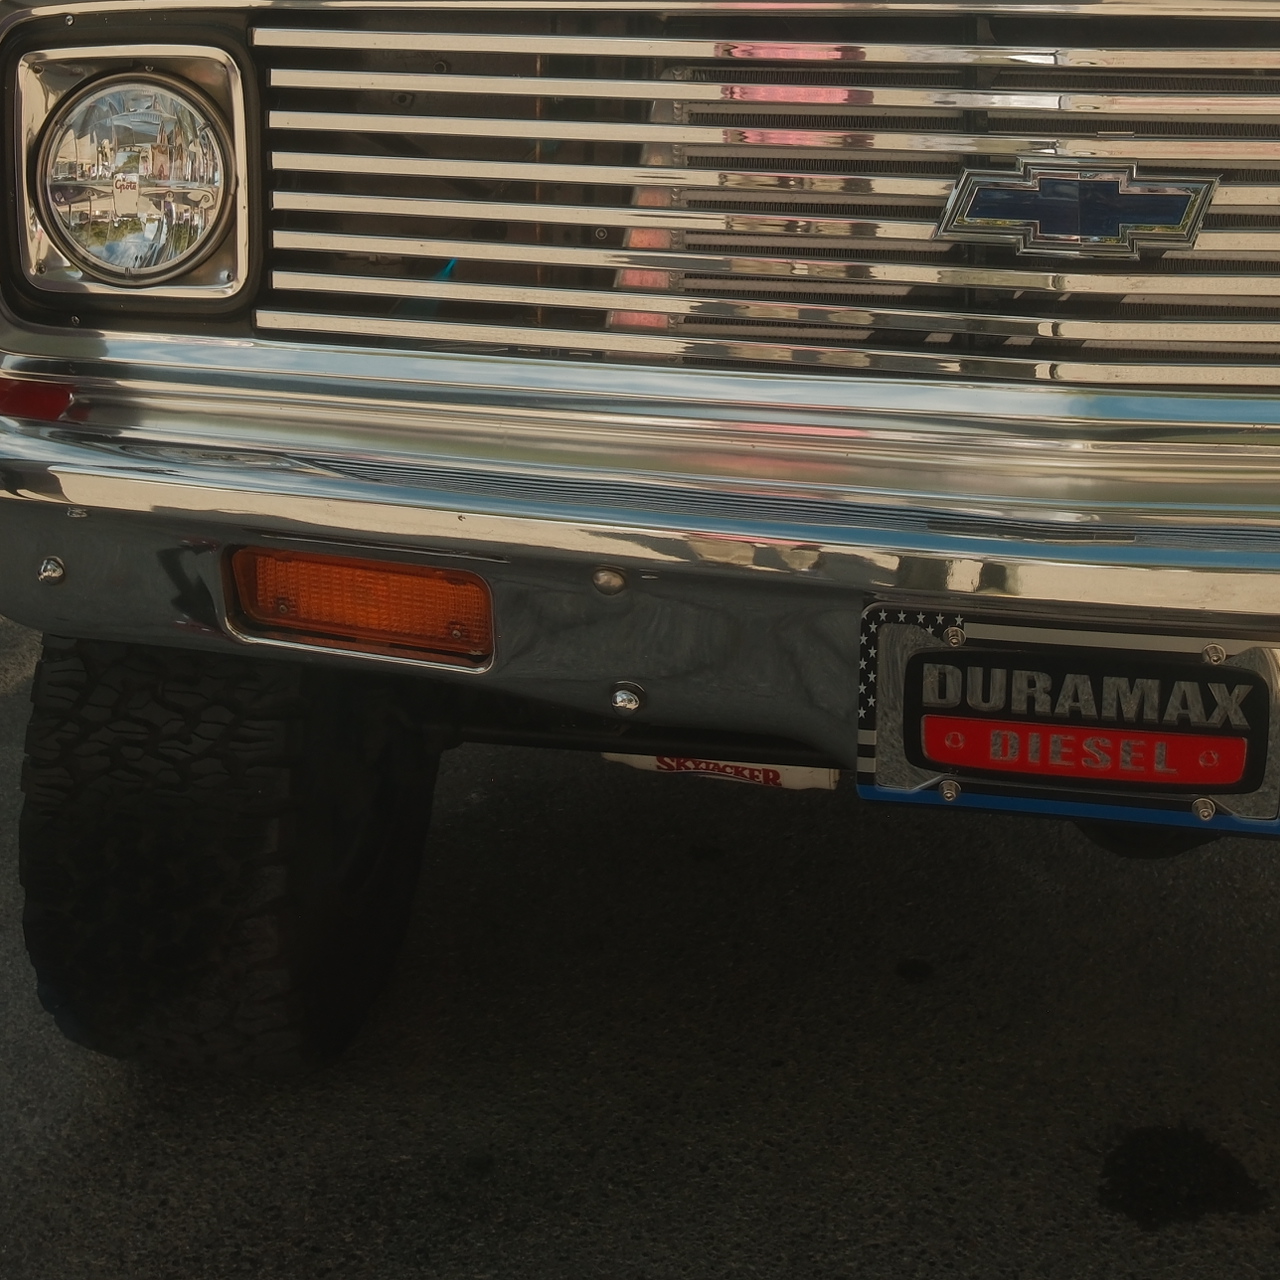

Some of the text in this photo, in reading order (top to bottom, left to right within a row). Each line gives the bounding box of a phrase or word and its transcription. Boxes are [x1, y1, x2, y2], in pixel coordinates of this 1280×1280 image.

[115, 179, 137, 193] Grote
[922, 663, 1253, 731] DURAMAX
[656, 756, 782, 786] SKYJACKER
[990, 729, 1177, 775] DIESEL
